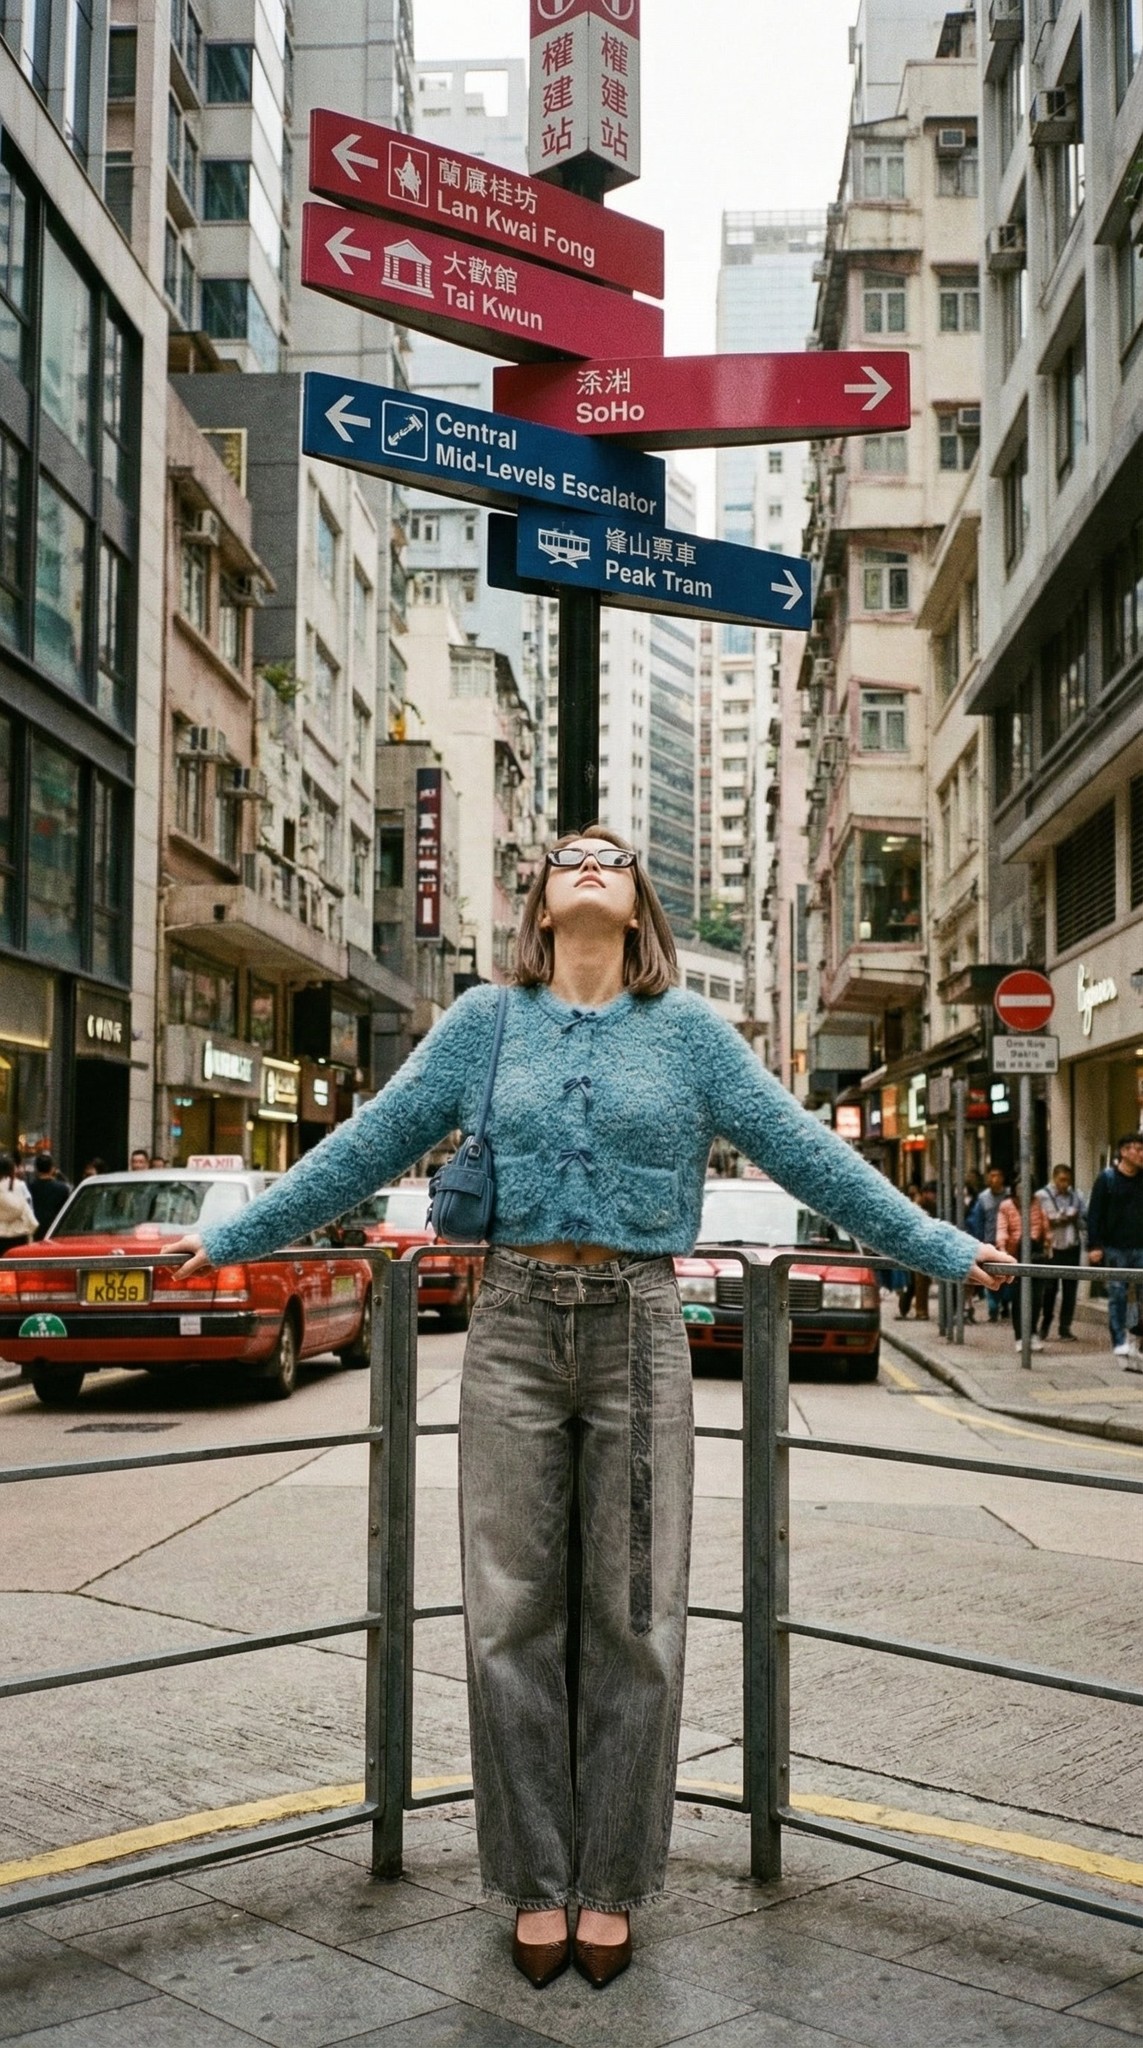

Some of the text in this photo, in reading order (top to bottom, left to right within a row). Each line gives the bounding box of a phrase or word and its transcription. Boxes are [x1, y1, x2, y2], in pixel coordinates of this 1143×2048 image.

[437, 190, 596, 269] Lan Kwai Fong
[442, 282, 543, 330] Tai Kwun
[435, 412, 517, 451] Central
[576, 401, 646, 424] SoHo
[436, 443, 657, 516] Mid-Levels Escalator
[606, 559, 713, 599] Peak Tram
